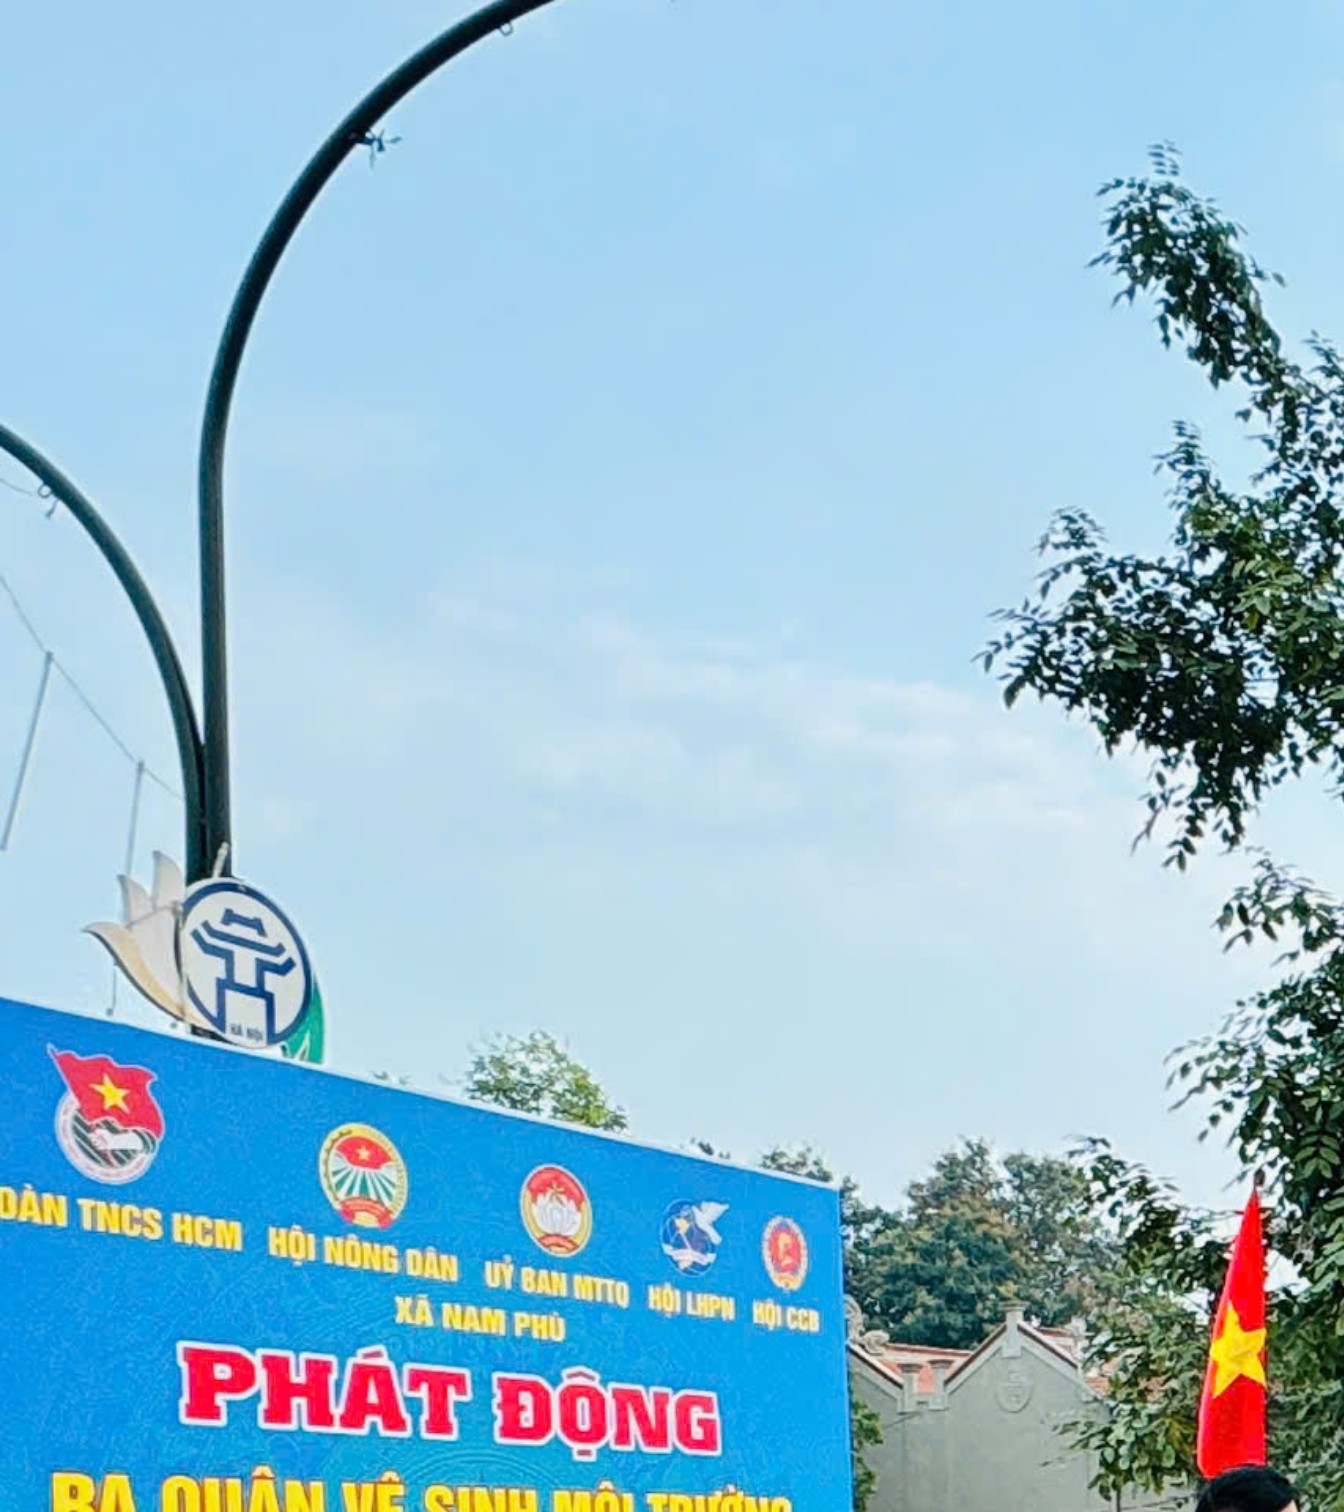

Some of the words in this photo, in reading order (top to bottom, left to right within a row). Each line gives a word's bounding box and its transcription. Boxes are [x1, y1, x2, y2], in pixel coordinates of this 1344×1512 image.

[77, 1198, 163, 1240] TNCS
[172, 1212, 243, 1251] HCM
[268, 1224, 315, 1266] HỘI
[324, 1234, 398, 1273] NÔNG
[406, 1246, 458, 1281] DÂN
[520, 1268, 568, 1297] BAN
[573, 1274, 630, 1308] MTTQ
[648, 1283, 681, 1318] HỘI
[686, 1290, 735, 1321] LHPN
[394, 1294, 434, 1327] XÃ
[441, 1302, 506, 1335] NAM
[513, 1311, 566, 1342] PHÙ
[752, 1299, 782, 1329] HỘI
[786, 1306, 820, 1332] CCB
[178, 1342, 470, 1438] PHÁT
[495, 1367, 719, 1459] ĐỘNG
